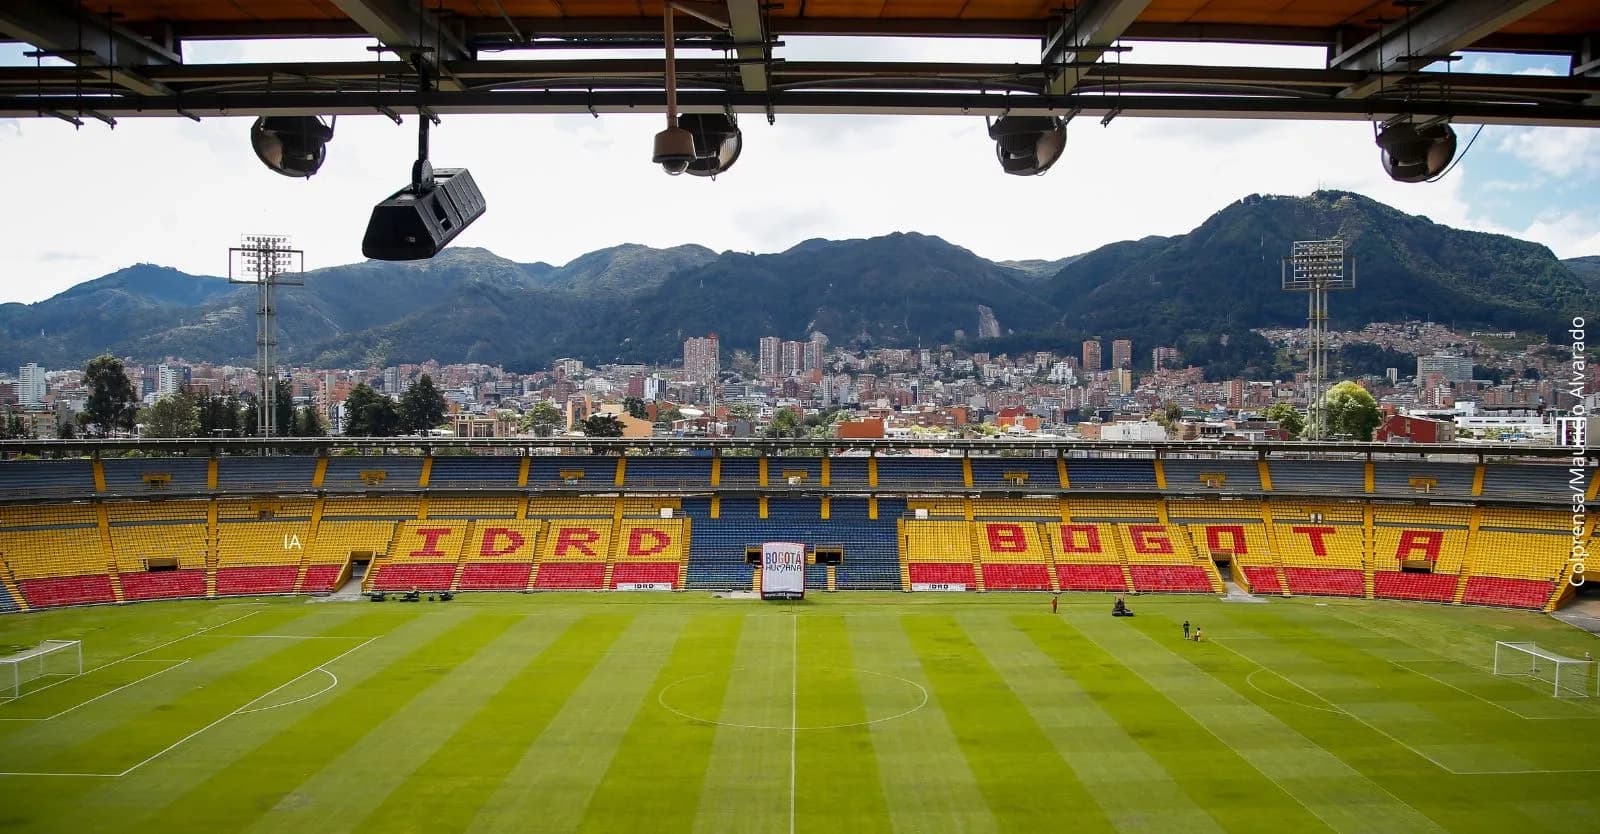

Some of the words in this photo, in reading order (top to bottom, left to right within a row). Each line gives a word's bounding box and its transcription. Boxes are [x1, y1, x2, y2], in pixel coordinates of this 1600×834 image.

[409, 527, 671, 557] IDRD
[986, 524, 1445, 561] BOGOTA
[765, 551, 802, 564] BOGOTÁ
